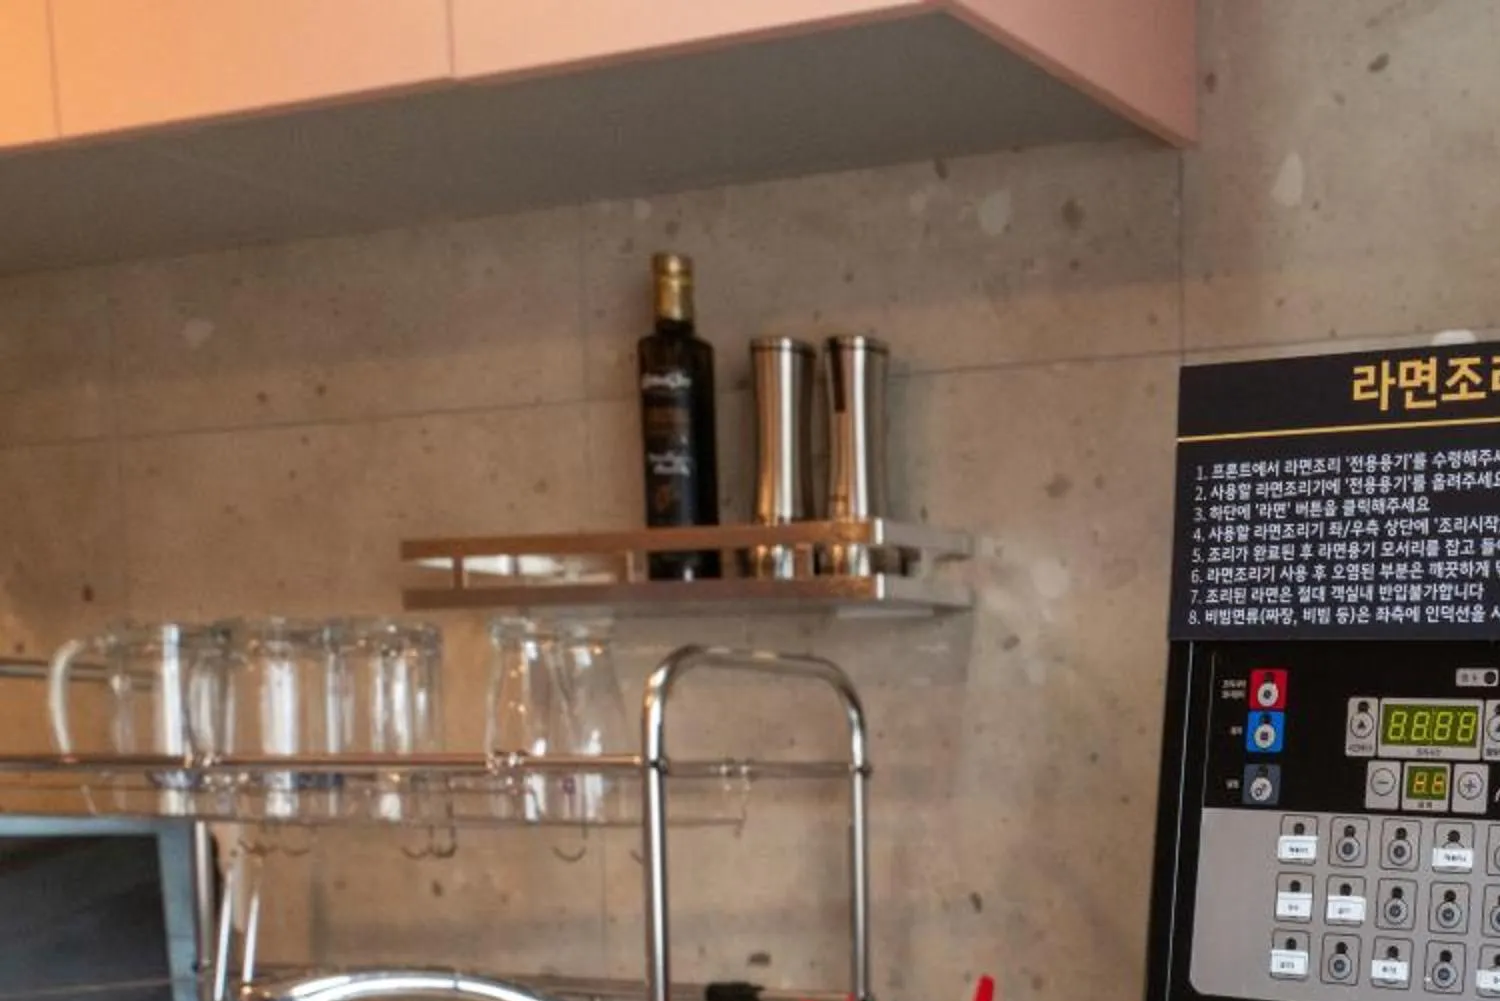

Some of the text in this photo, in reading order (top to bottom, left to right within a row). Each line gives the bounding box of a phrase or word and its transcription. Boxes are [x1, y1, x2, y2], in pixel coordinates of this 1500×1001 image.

[1196, 466, 1208, 481] 1.
[1212, 460, 1279, 480] 프론트에서
[1284, 456, 1341, 476] 라면조리
[1346, 452, 1426, 471] '전용용기'를
[1195, 487, 1206, 501] 2.
[1211, 484, 1251, 501] 사용할
[1255, 478, 1341, 497] 라면조리기에
[1345, 474, 1426, 494] '전용용기'를
[1194, 496, 1430, 522] 3. 하단에 '라면' 버튼을 클릭해주세요
[1193, 529, 1205, 543] 4.
[1208, 525, 1249, 543] 사용할
[1254, 521, 1323, 541] 라면조리기
[1329, 519, 1380, 538] 좌/우측
[1384, 517, 1428, 536] 상단에
[1192, 549, 1204, 563] 5.
[1207, 545, 1248, 563] 조리가
[1254, 543, 1294, 561] 완료된
[1300, 542, 1312, 560] 후
[1318, 541, 1375, 560] 라면용기
[1381, 539, 1438, 558] 모서리를
[1445, 538, 1475, 556] 잡고
[1191, 570, 1203, 584] 6.
[1207, 566, 1275, 584] 라면조리기
[1280, 564, 1308, 582] 사용
[1312, 563, 1326, 581] 후
[1331, 562, 1375, 581] 오염된
[1379, 561, 1424, 579] 부분은
[1429, 560, 1489, 579] 깨끗하게
[1191, 583, 1484, 604] 7. 조리된 라면은 절대 객실내 반입불가합니다
[1188, 611, 1200, 625] 8.
[1303, 607, 1330, 625] 비빔
[1336, 606, 1369, 625] 등)은
[1376, 606, 1420, 624] 좌측에
